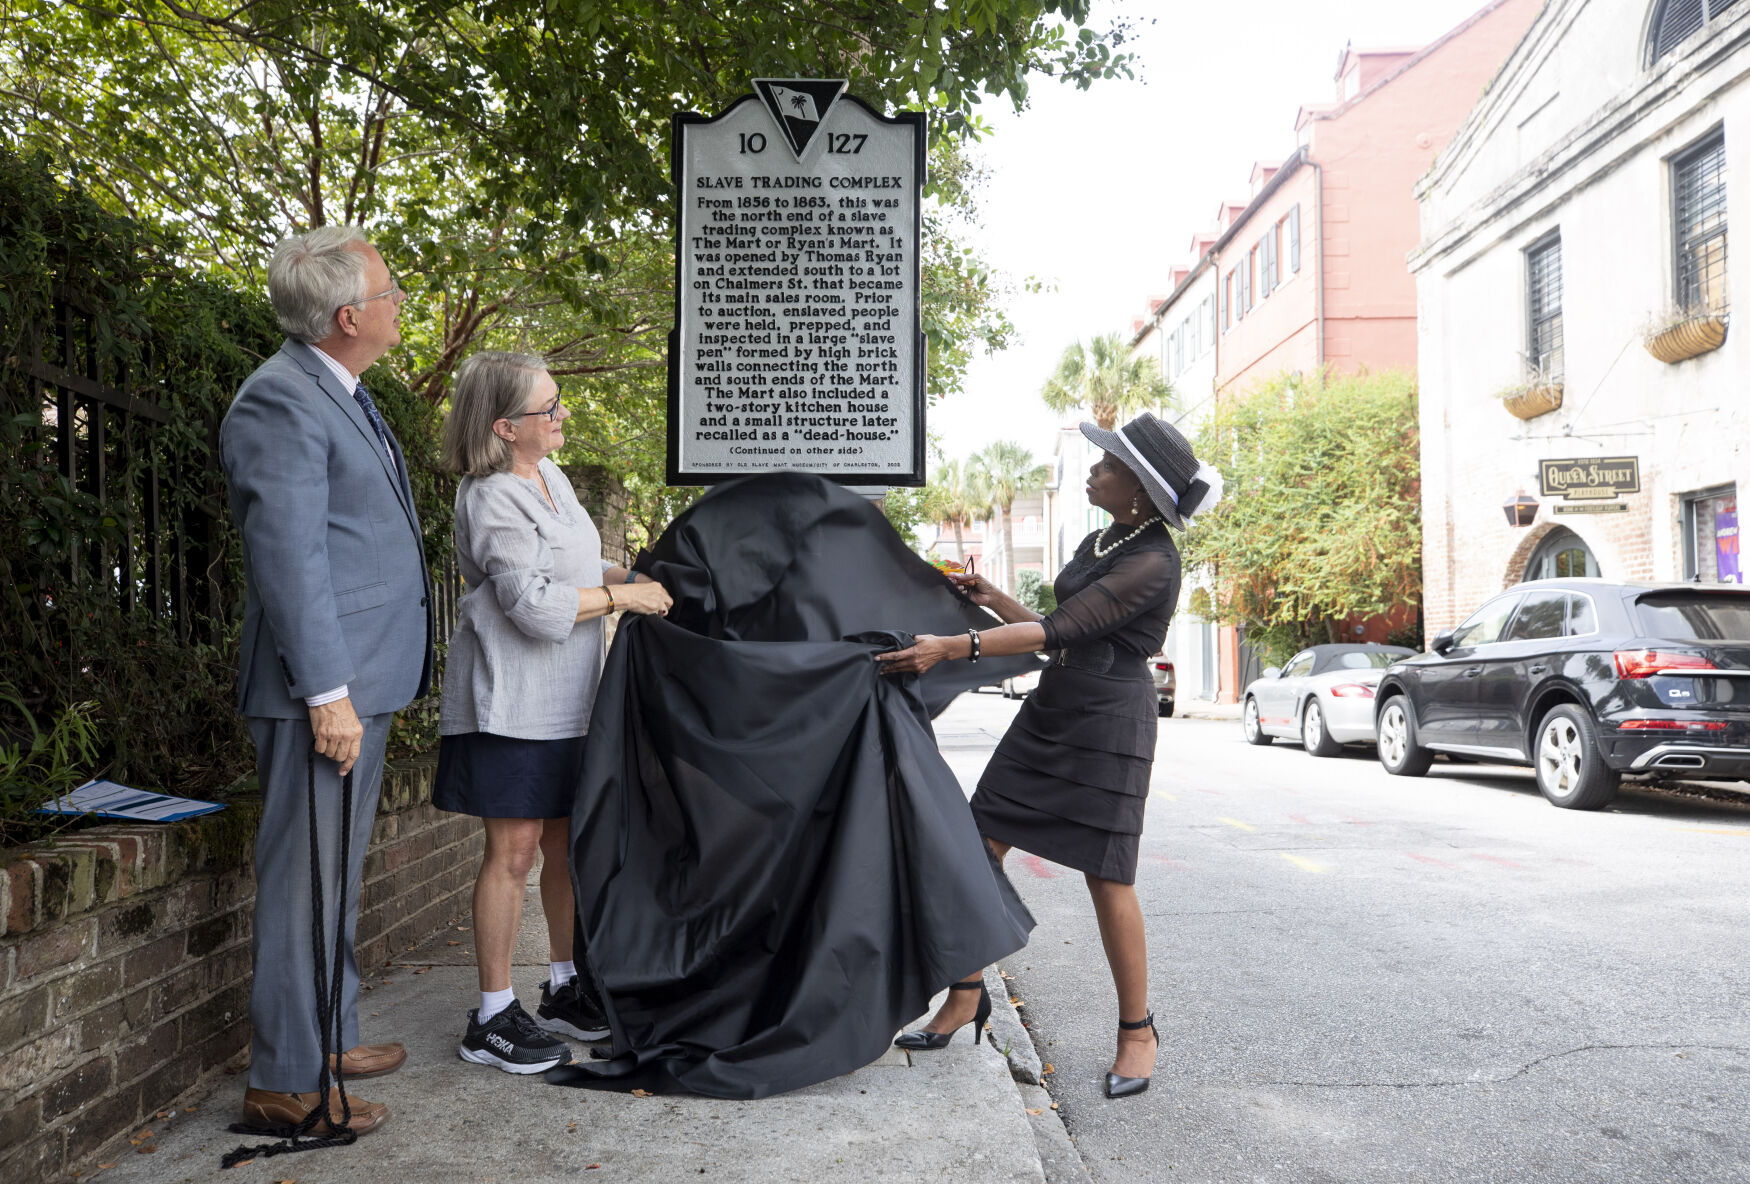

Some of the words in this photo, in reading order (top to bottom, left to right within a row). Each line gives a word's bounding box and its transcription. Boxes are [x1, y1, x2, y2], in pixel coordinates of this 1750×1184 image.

[739, 132, 767, 154] 10
[827, 132, 868, 154] 127
[696, 176, 743, 189] SLAVE
[750, 176, 822, 189] TRADING
[829, 176, 902, 189] COMPLEX
[697, 196, 733, 208] From
[737, 196, 770, 208] 1856
[774, 197, 790, 208] to
[793, 196, 831, 210] 1863,
[838, 196, 867, 208] this
[872, 200, 899, 208] was
[711, 209, 736, 222] the
[740, 209, 783, 222] north
[786, 209, 814, 222] end
[818, 209, 834, 222] of
[838, 213, 846, 222] a
[851, 209, 886, 222] slave
[701, 223, 757, 238] trading
[760, 223, 822, 238] complex
[827, 223, 875, 235] known
[879, 226, 894, 235] as
[691, 236, 722, 249] The
[725, 236, 762, 249] Mart
[765, 240, 782, 249] or
[839, 236, 880, 249] Mart.
[890, 236, 902, 249] It
[694, 253, 721, 262] was
[724, 250, 777, 266] opened
[780, 250, 803, 266] by
[804, 250, 860, 262] Thomas
[864, 250, 903, 266] Ryan
[697, 263, 725, 276] and
[728, 263, 799, 276] extended
[803, 263, 844, 276] south
[848, 264, 864, 276] to
[866, 267, 875, 276] a
[876, 263, 900, 276] lot
[693, 280, 711, 289] on
[715, 277, 783, 289] Chalmers
[787, 277, 808, 289] St.
[812, 277, 844, 289] that
[848, 277, 903, 289] became
[702, 291, 721, 303] its
[724, 291, 760, 303] main
[765, 291, 800, 303] sales
[804, 294, 846, 303] room.
[854, 291, 893, 303] Prior
[697, 305, 713, 316] to
[717, 304, 776, 318] auction,
[782, 304, 846, 316] enslaved
[850, 304, 899, 320] people
[704, 322, 741, 330] were
[744, 318, 781, 332] held,
[788, 318, 856, 334] prepped,
[863, 318, 891, 330] and
[698, 331, 772, 346] inspected
[776, 331, 793, 343] in
[795, 334, 804, 343] a
[808, 331, 847, 346] large
[735, 345, 789, 357] formed
[794, 345, 813, 360] by
[817, 345, 851, 360] high
[857, 345, 898, 357] brick
[694, 359, 733, 371] walls
[736, 359, 819, 374] connecting
[823, 359, 848, 371] the
[855, 359, 898, 371] north
[694, 373, 722, 385] and
[726, 373, 767, 385] south
[771, 373, 805, 385] ends
[810, 373, 826, 385] of
[829, 373, 854, 385] the
[859, 373, 899, 385] Mart.
[703, 386, 734, 398] The
[738, 386, 775, 398] Mart
[778, 386, 808, 398] also
[811, 386, 876, 398] included
[880, 389, 889, 398] a
[705, 401, 782, 416] two-story
[784, 400, 842, 412] kitchen
[847, 400, 889, 412] house
[699, 414, 728, 426] and
[731, 417, 740, 426] a
[744, 414, 783, 426] small
[786, 415, 858, 426] structure
[862, 414, 898, 426] later
[695, 428, 758, 440] recalled
[762, 431, 777, 440] as
[781, 431, 790, 440] a
[729, 446, 786, 454] (Continued
[806, 446, 834, 454] other
[837, 446, 864, 454] side)
[1548, 466, 1587, 489] QUEEN
[1587, 465, 1632, 486] STREET
[485, 1032, 514, 1055] HOKA
